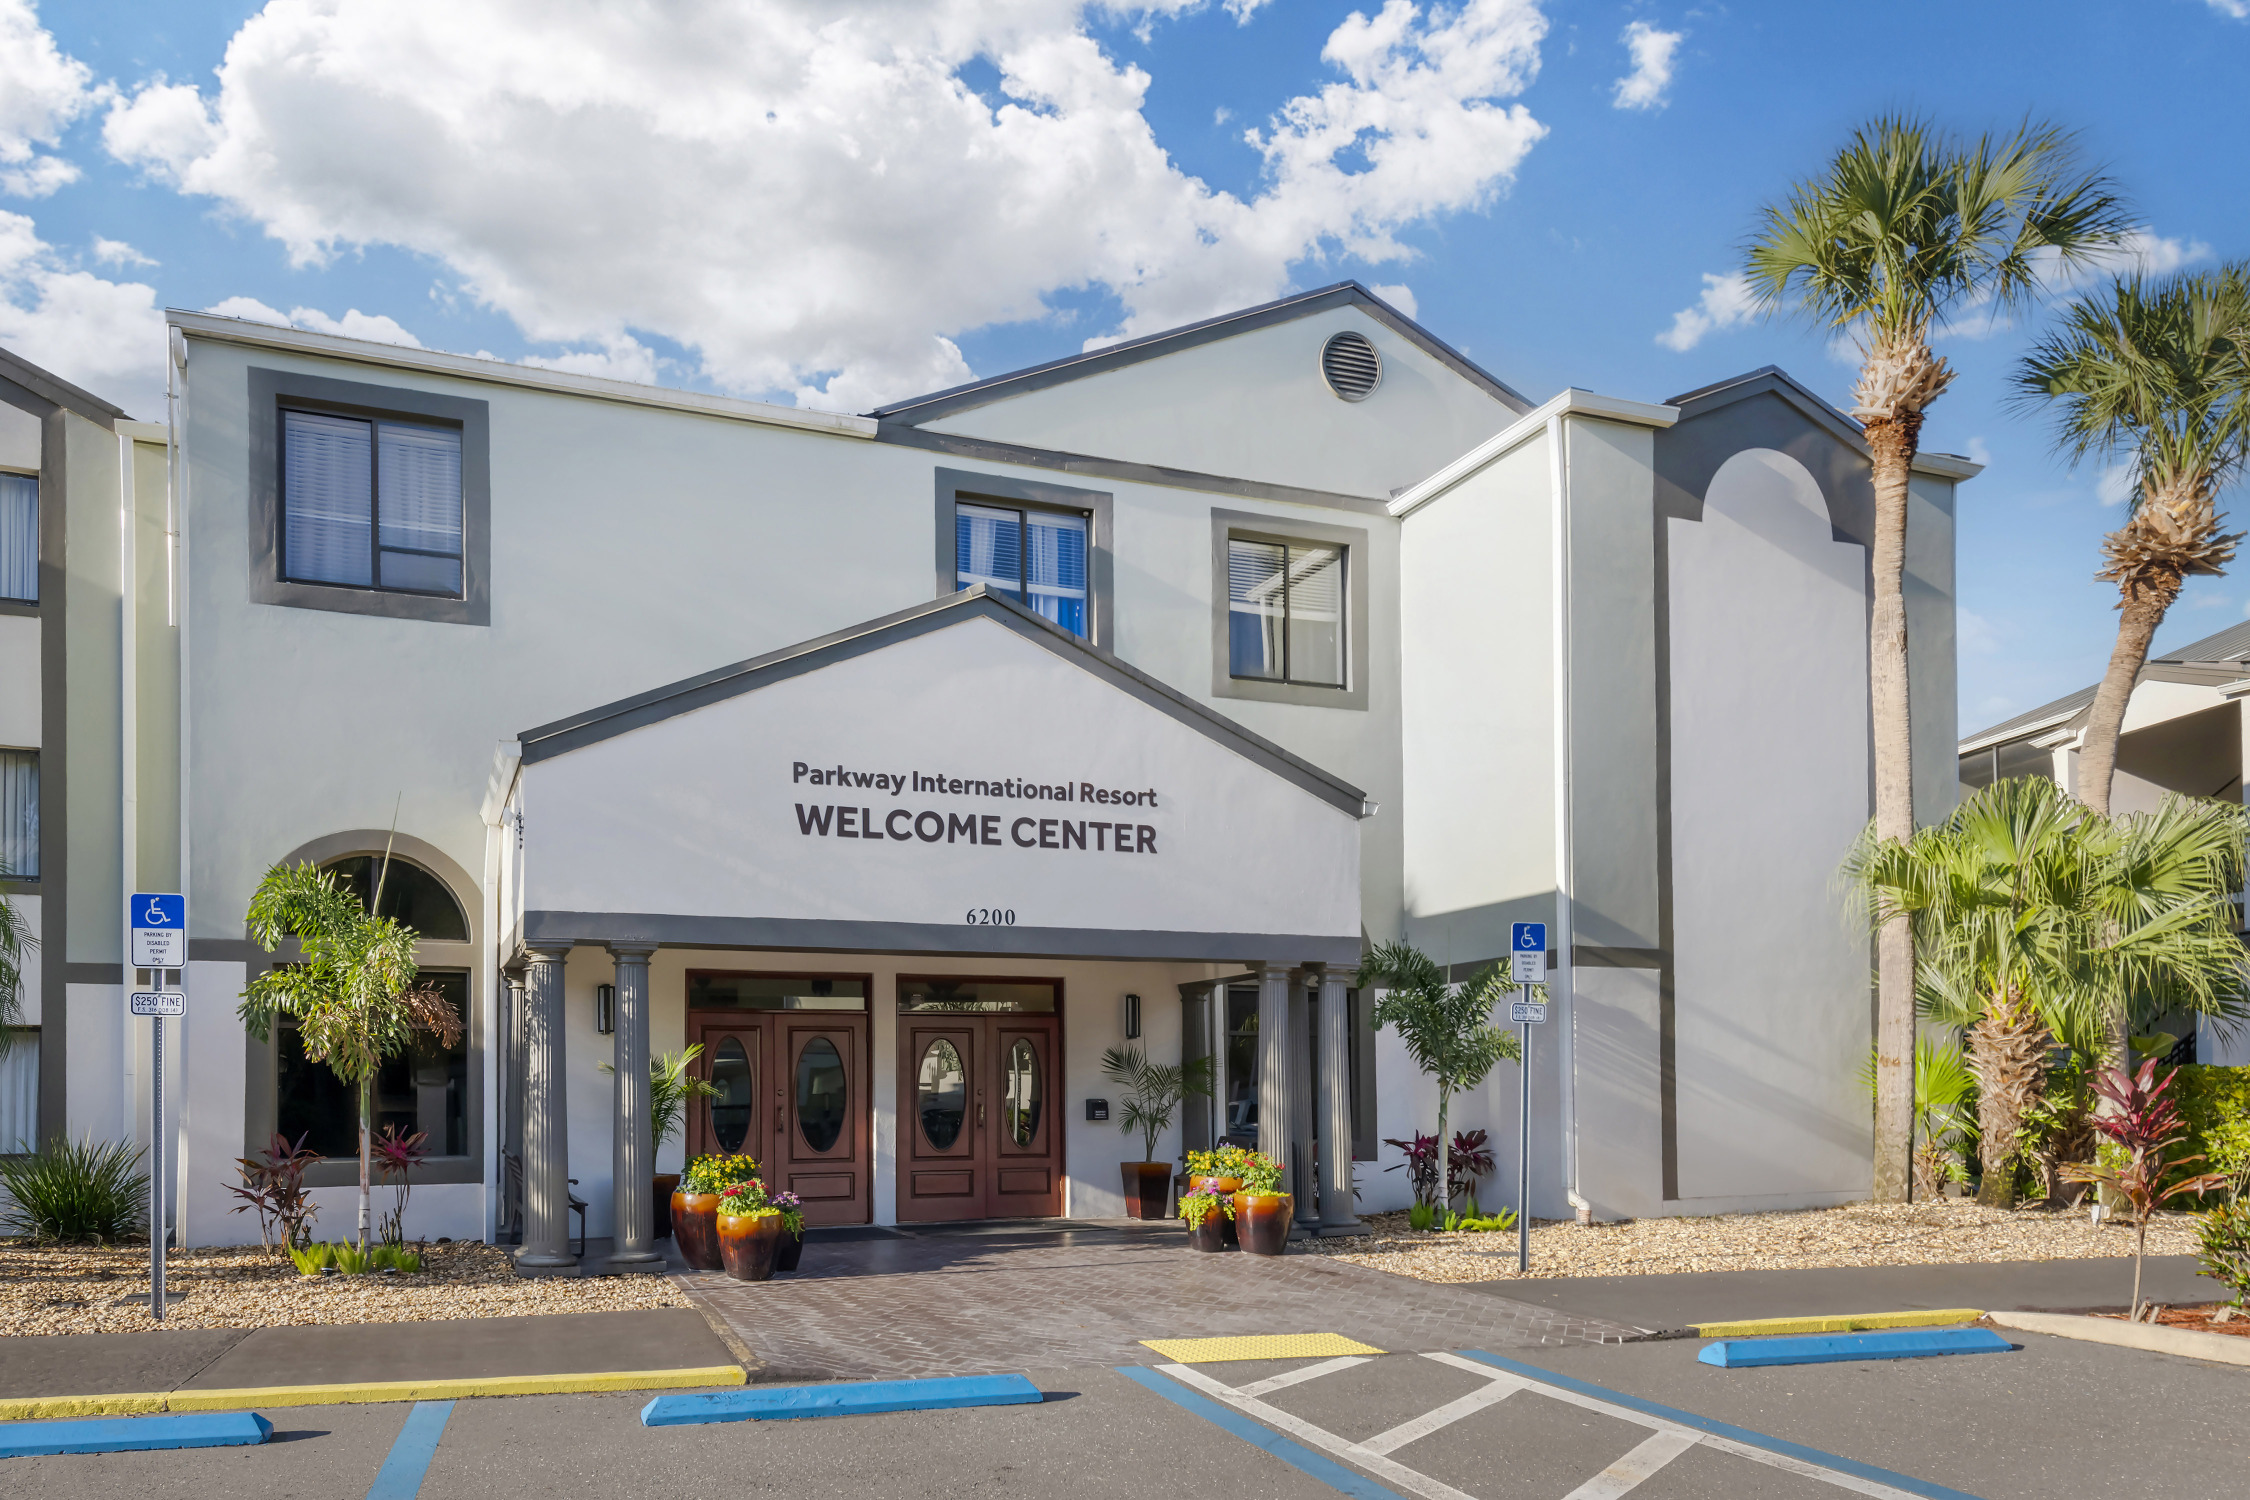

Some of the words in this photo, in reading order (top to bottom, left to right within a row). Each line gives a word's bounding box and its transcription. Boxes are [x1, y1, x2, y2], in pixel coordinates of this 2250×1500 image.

[792, 761, 906, 796] Parkway
[912, 770, 1074, 802] International
[1080, 782, 1158, 808] Resort
[795, 803, 1002, 846] WELCOME
[1011, 817, 1158, 854] CENTER
[966, 908, 1016, 926] 6200
[135, 996, 158, 1006] $250
[162, 997, 180, 1006] FINE
